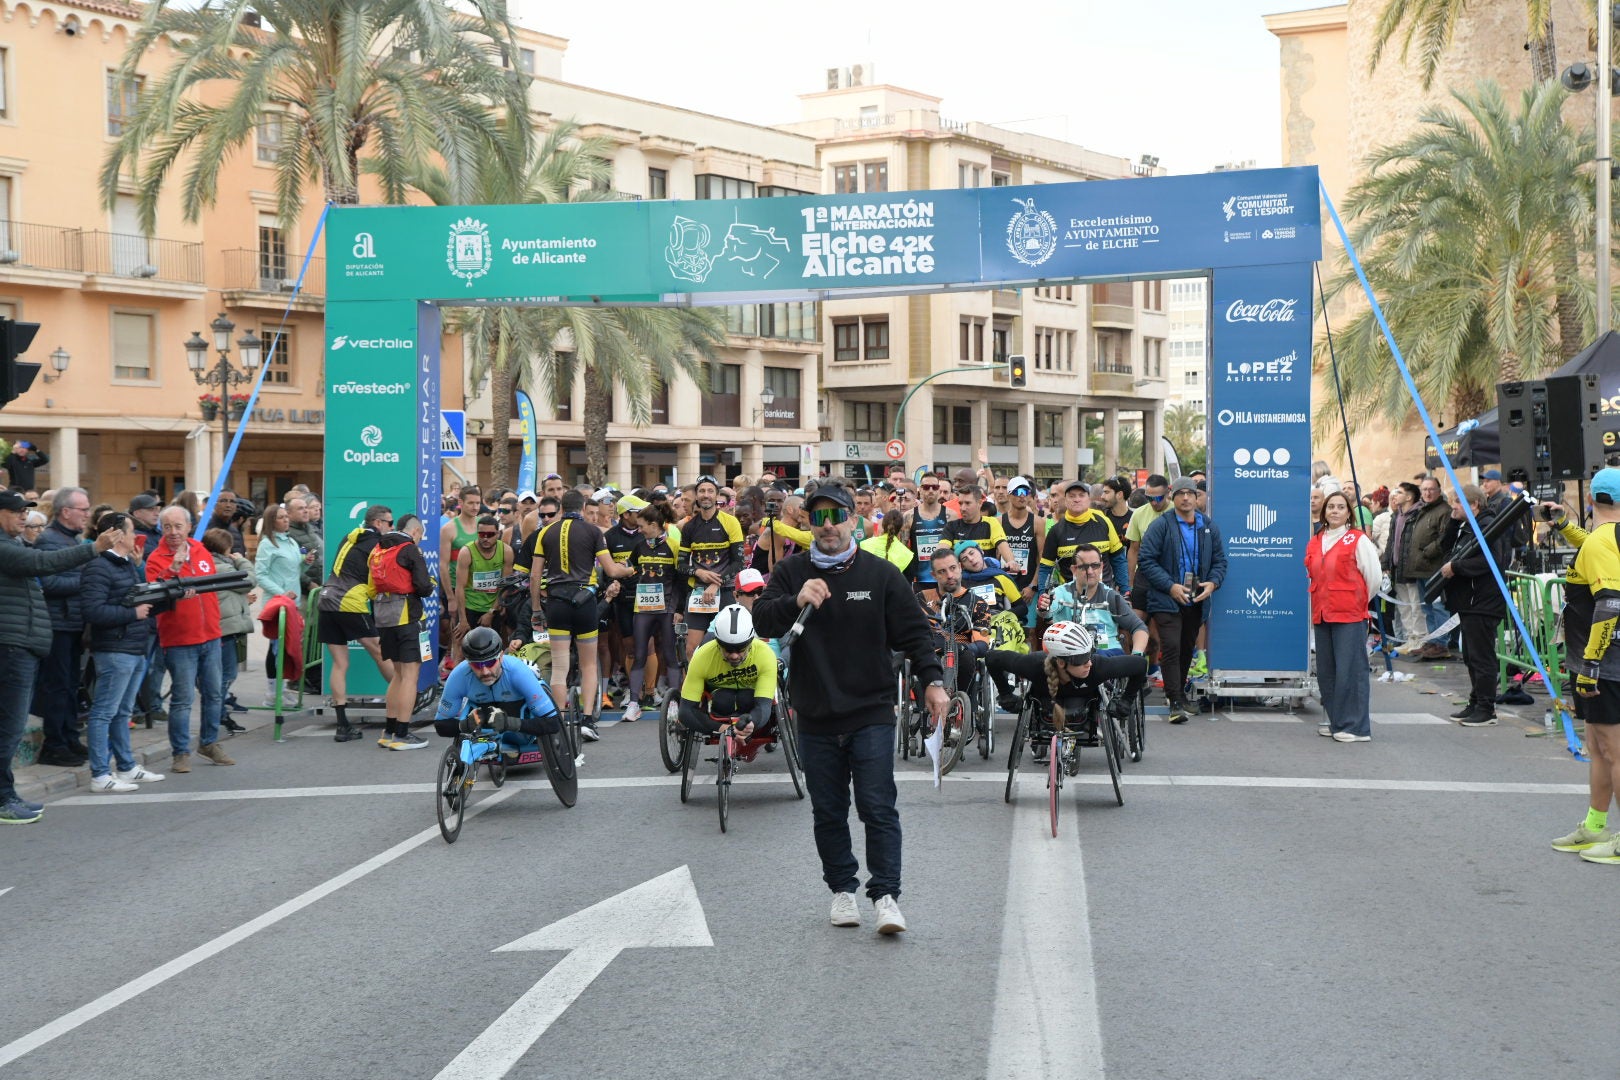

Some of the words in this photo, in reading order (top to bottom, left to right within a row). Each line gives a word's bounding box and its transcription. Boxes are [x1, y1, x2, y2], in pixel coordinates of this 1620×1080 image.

[830, 198, 935, 222] MARATÓN
[1237, 199, 1288, 209] COMUNITAT
[1241, 209, 1253, 217] DE
[1254, 206, 1295, 216] L'ESPORT
[830, 217, 935, 231] INTERNACIONAL
[1070, 215, 1153, 229] Excelentísimo
[1064, 225, 1160, 240] AYUNTAMIENTO
[501, 237, 597, 252] Ayuntamiento
[802, 231, 887, 257] Elche
[889, 235, 935, 253] 42K
[1085, 240, 1100, 251] de
[1102, 238, 1140, 250] ELCHE
[512, 253, 529, 265] de
[532, 252, 587, 265] Alicante
[802, 250, 936, 277] Alicante
[1225, 299, 1299, 323] Coca-Cola
[349, 337, 413, 349] vectalia
[1227, 362, 1293, 374] LOPEZ
[1235, 411, 1252, 424] HLA
[1253, 413, 1306, 423] VISTAHERMOSA
[421, 354, 431, 541] MONTEMAR
[343, 449, 400, 466] Coplaca
[1234, 468, 1290, 479] Securitas
[1228, 537, 1269, 545] ALICANTE
[1271, 537, 1294, 545] PORT
[640, 595, 660, 603] 2803
